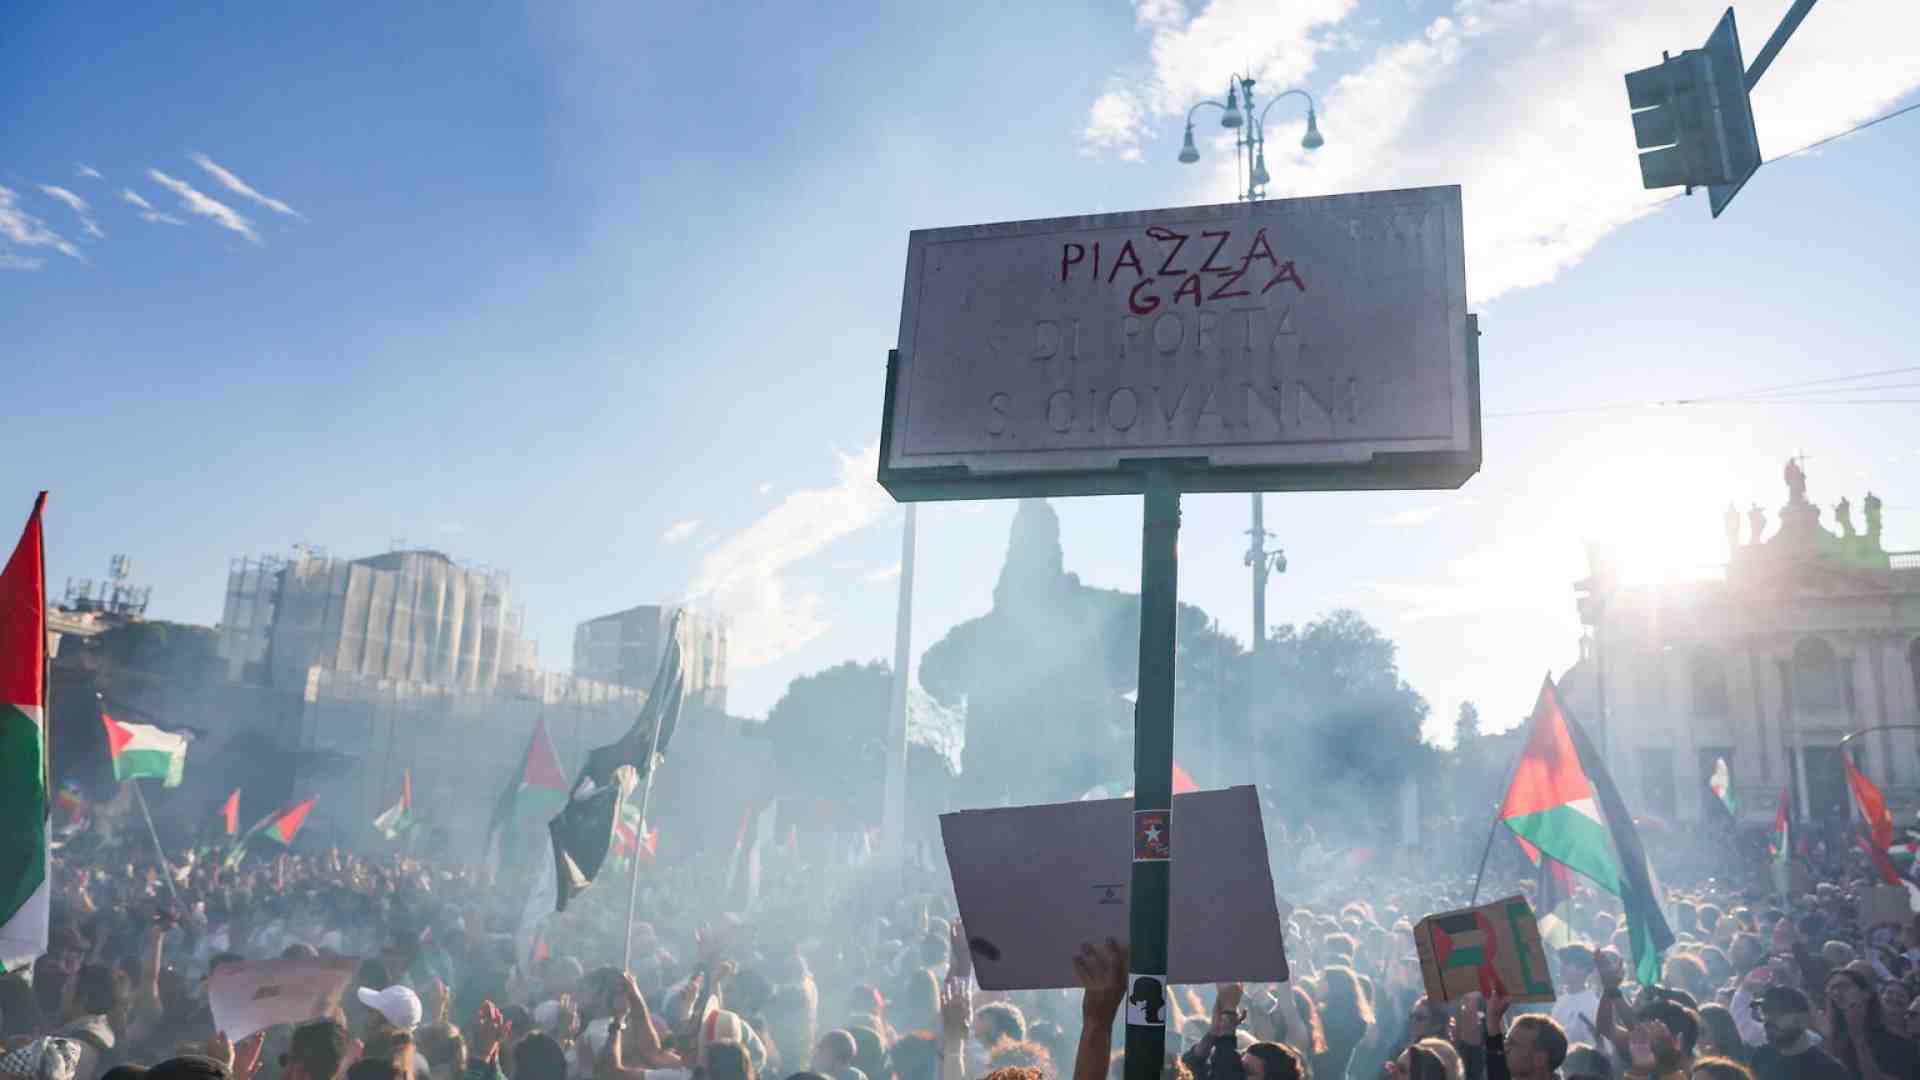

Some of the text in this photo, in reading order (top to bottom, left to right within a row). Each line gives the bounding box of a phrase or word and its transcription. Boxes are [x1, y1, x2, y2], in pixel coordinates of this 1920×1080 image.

[1061, 227, 1278, 284] PIAZZA
[1128, 260, 1306, 315] GAZA
[1032, 303, 1309, 361] DI PORTA
[985, 376, 1357, 439] S. GIOVANNI
